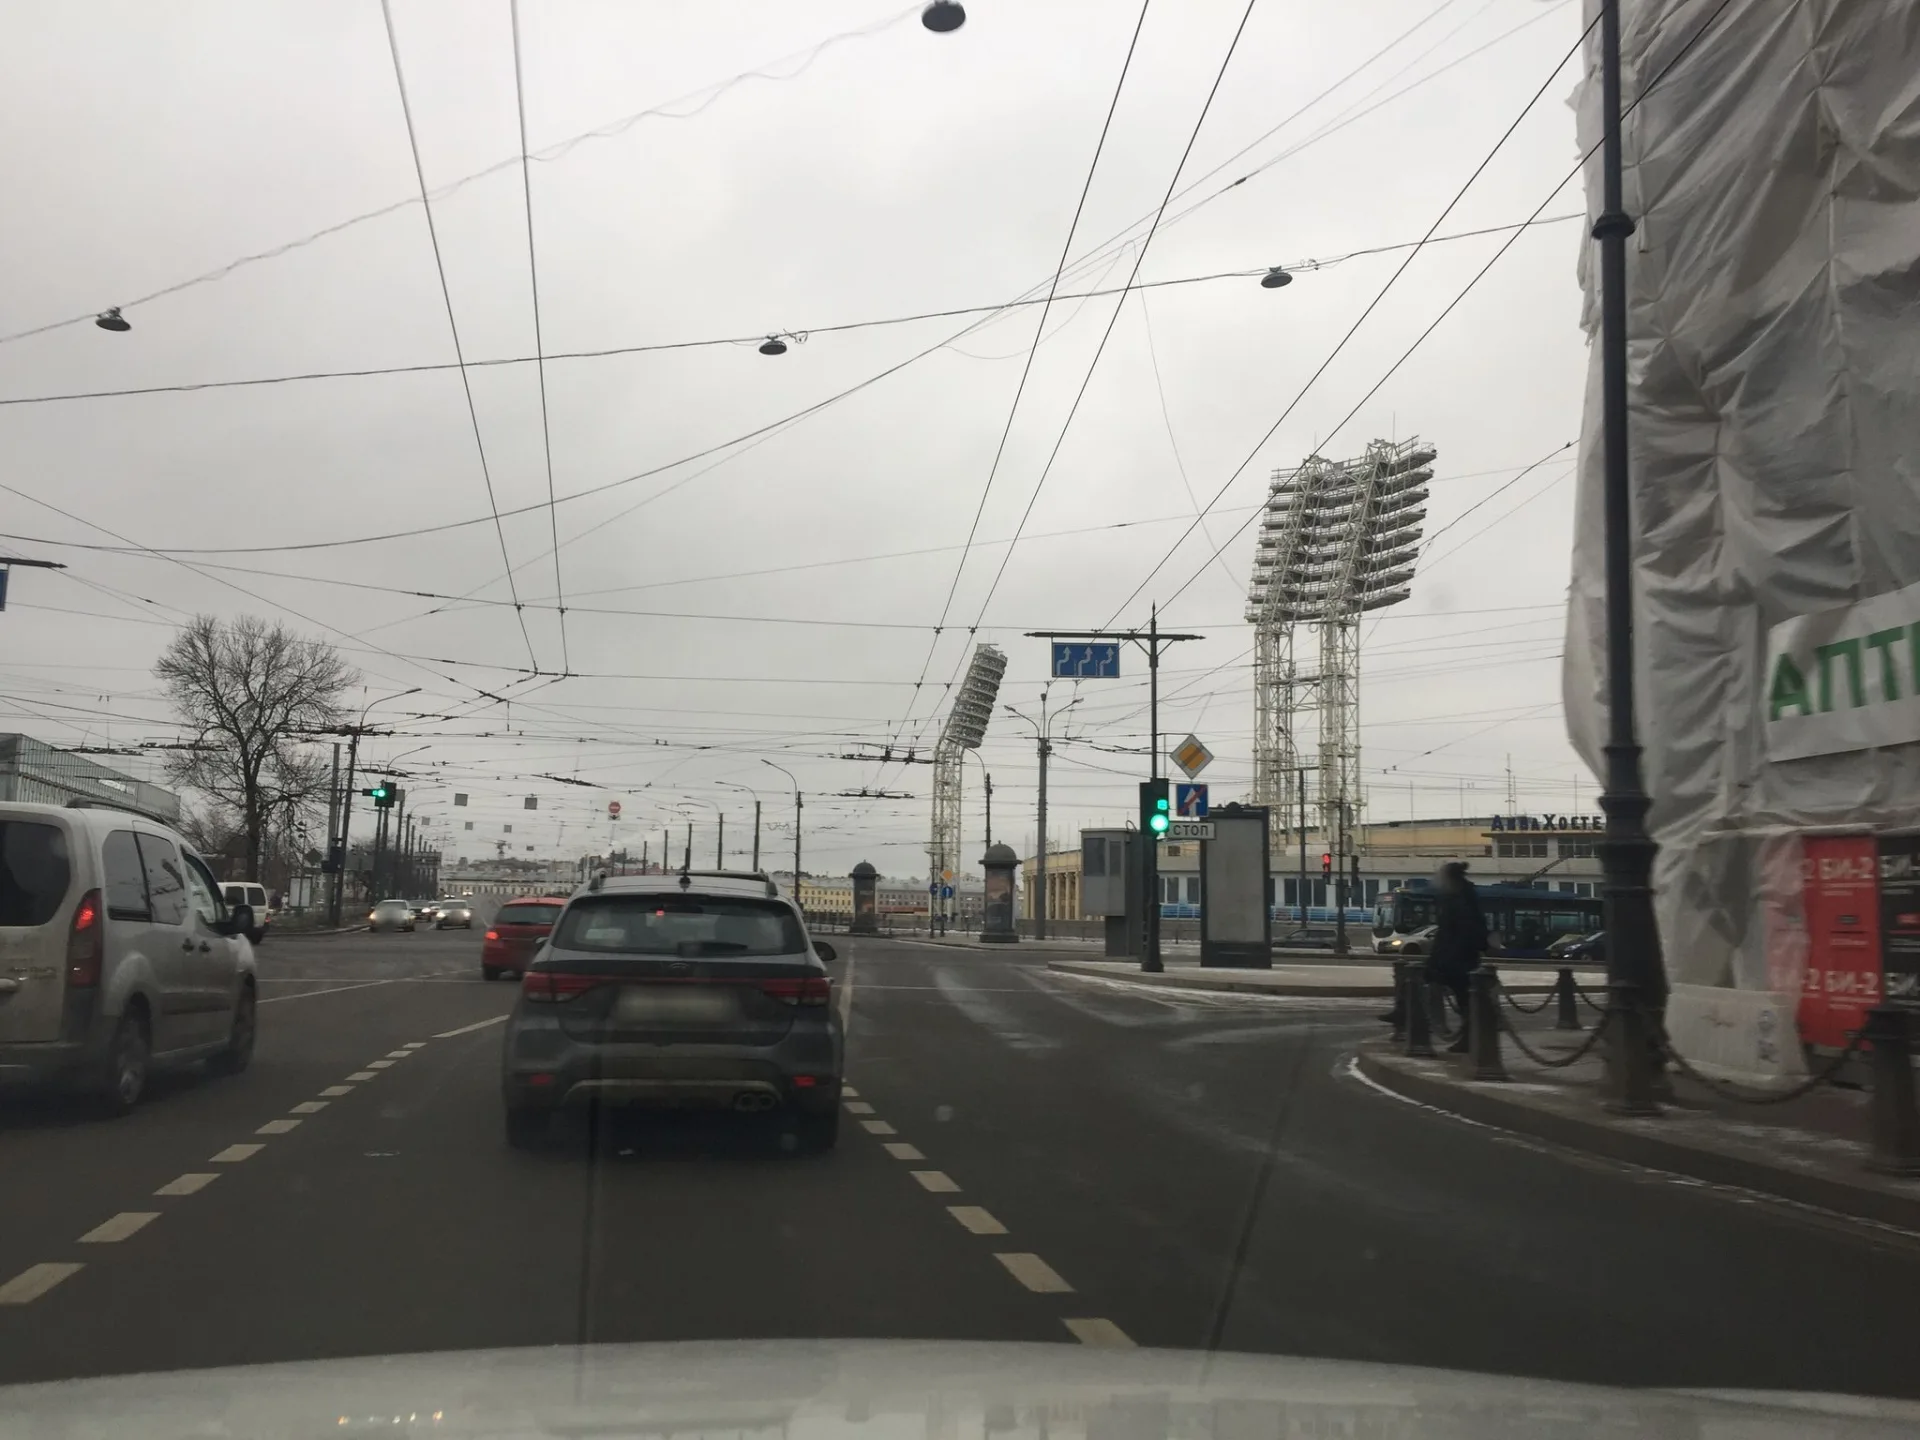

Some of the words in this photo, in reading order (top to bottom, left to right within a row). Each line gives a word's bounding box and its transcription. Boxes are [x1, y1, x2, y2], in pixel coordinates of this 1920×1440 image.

[1173, 825, 1208, 836] СТОП
[1819, 857, 1875, 880] БИ-2
[1879, 854, 1920, 879] БИ-
[1824, 970, 1879, 995] БИ-2
